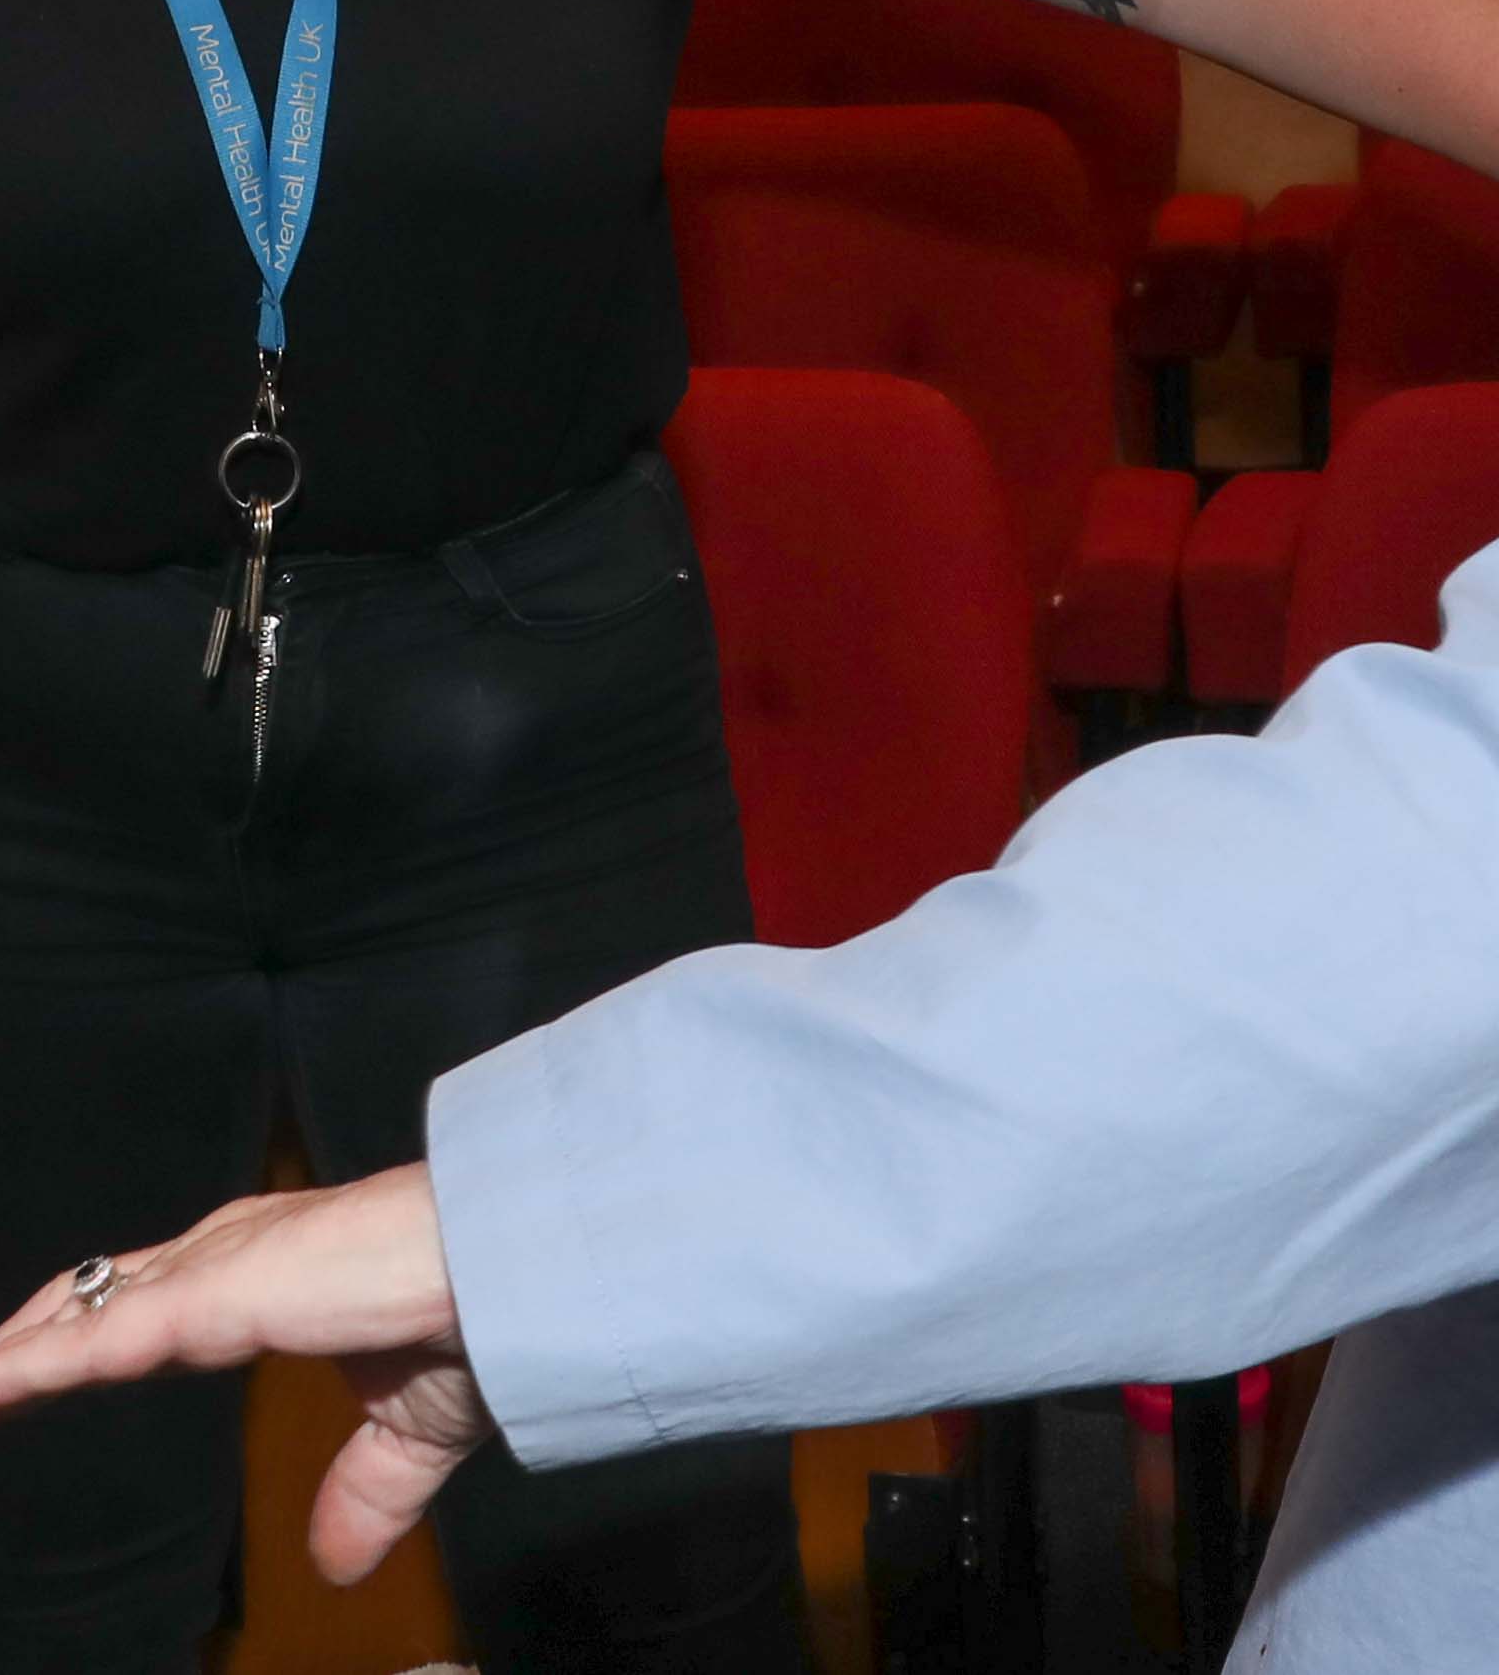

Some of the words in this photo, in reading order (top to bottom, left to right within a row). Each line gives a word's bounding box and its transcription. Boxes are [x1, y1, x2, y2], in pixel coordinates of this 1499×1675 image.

[297, 20, 324, 64] UK
[190, 23, 243, 117] Mental
[223, 124, 261, 217] Health
[282, 71, 318, 164] Health
[275, 174, 306, 272] Mental
